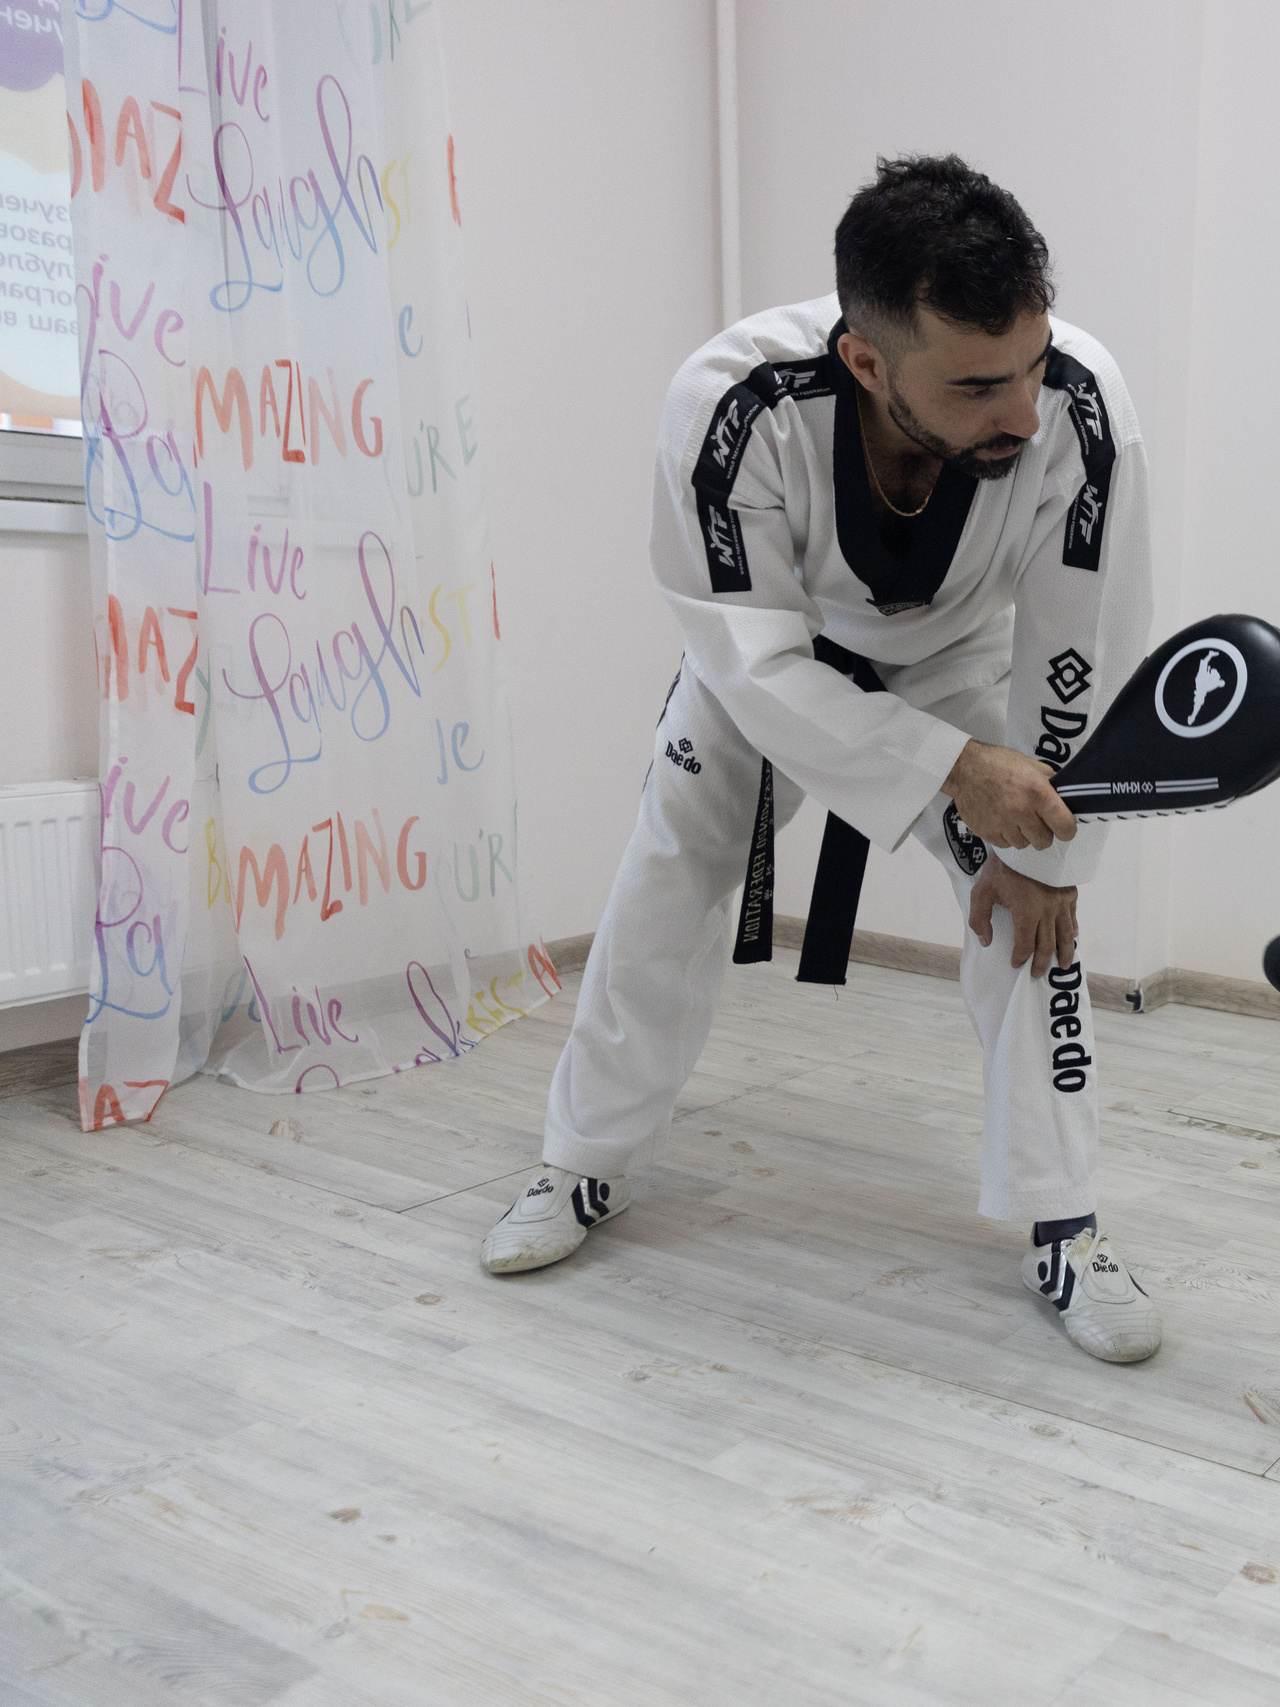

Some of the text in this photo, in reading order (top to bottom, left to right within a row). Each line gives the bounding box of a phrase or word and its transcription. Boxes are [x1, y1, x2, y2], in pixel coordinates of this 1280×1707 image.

[187, 75, 384, 313] Laugh
[192, 358, 384, 472] MAZING
[710, 399, 741, 469] WTF
[1077, 382, 1103, 441] WTF
[203, 481, 307, 600] Live
[707, 504, 736, 568] WTF
[1079, 484, 1103, 545] WTF
[222, 531, 426, 795] Laugh
[665, 740, 702, 775] Daedo
[1112, 781, 1141, 794] KHAN
[232, 807, 427, 941] MAZING
[243, 954, 359, 1054] Live
[1048, 960, 1092, 1093] Daedo
[526, 1184, 554, 1197] Daedo
